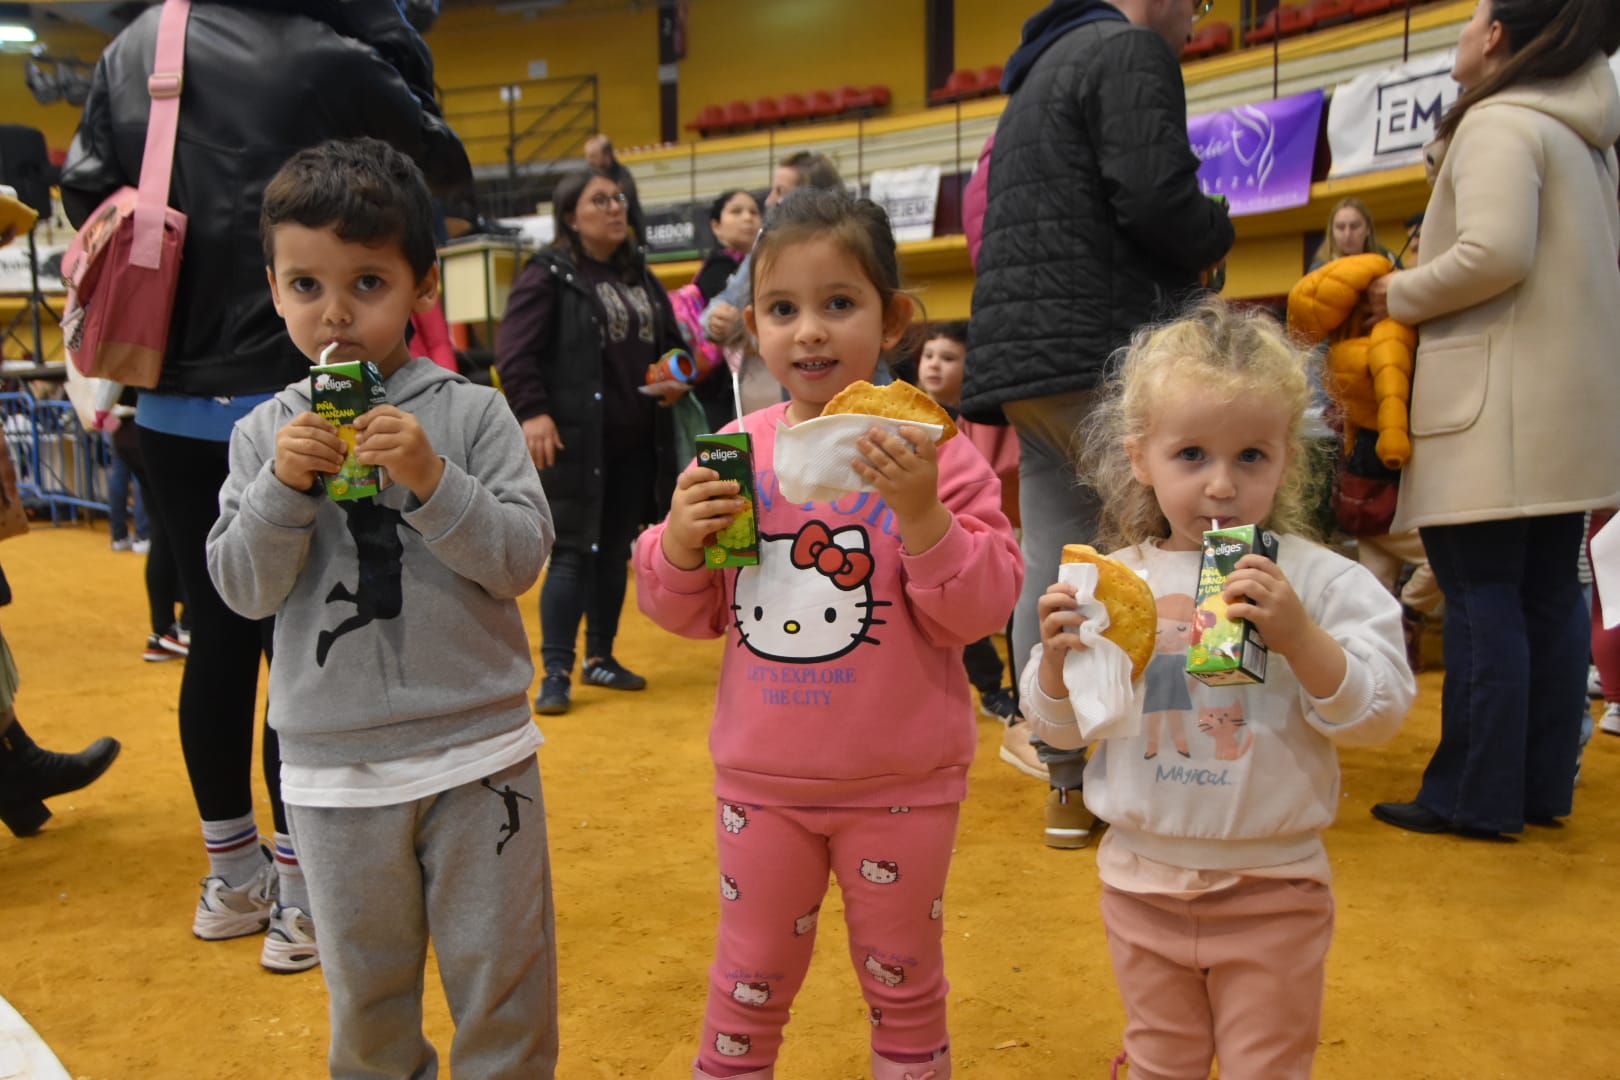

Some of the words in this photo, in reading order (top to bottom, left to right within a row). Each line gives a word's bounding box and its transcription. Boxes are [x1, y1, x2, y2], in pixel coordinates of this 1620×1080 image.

[1389, 90, 1456, 133] EM
[645, 222, 694, 240] EJEDOR
[710, 448, 738, 461] eliges
[1215, 543, 1242, 556] eliges
[781, 666, 857, 684] EXPLORE
[762, 692, 791, 704] THE
[793, 693, 832, 705] CITY
